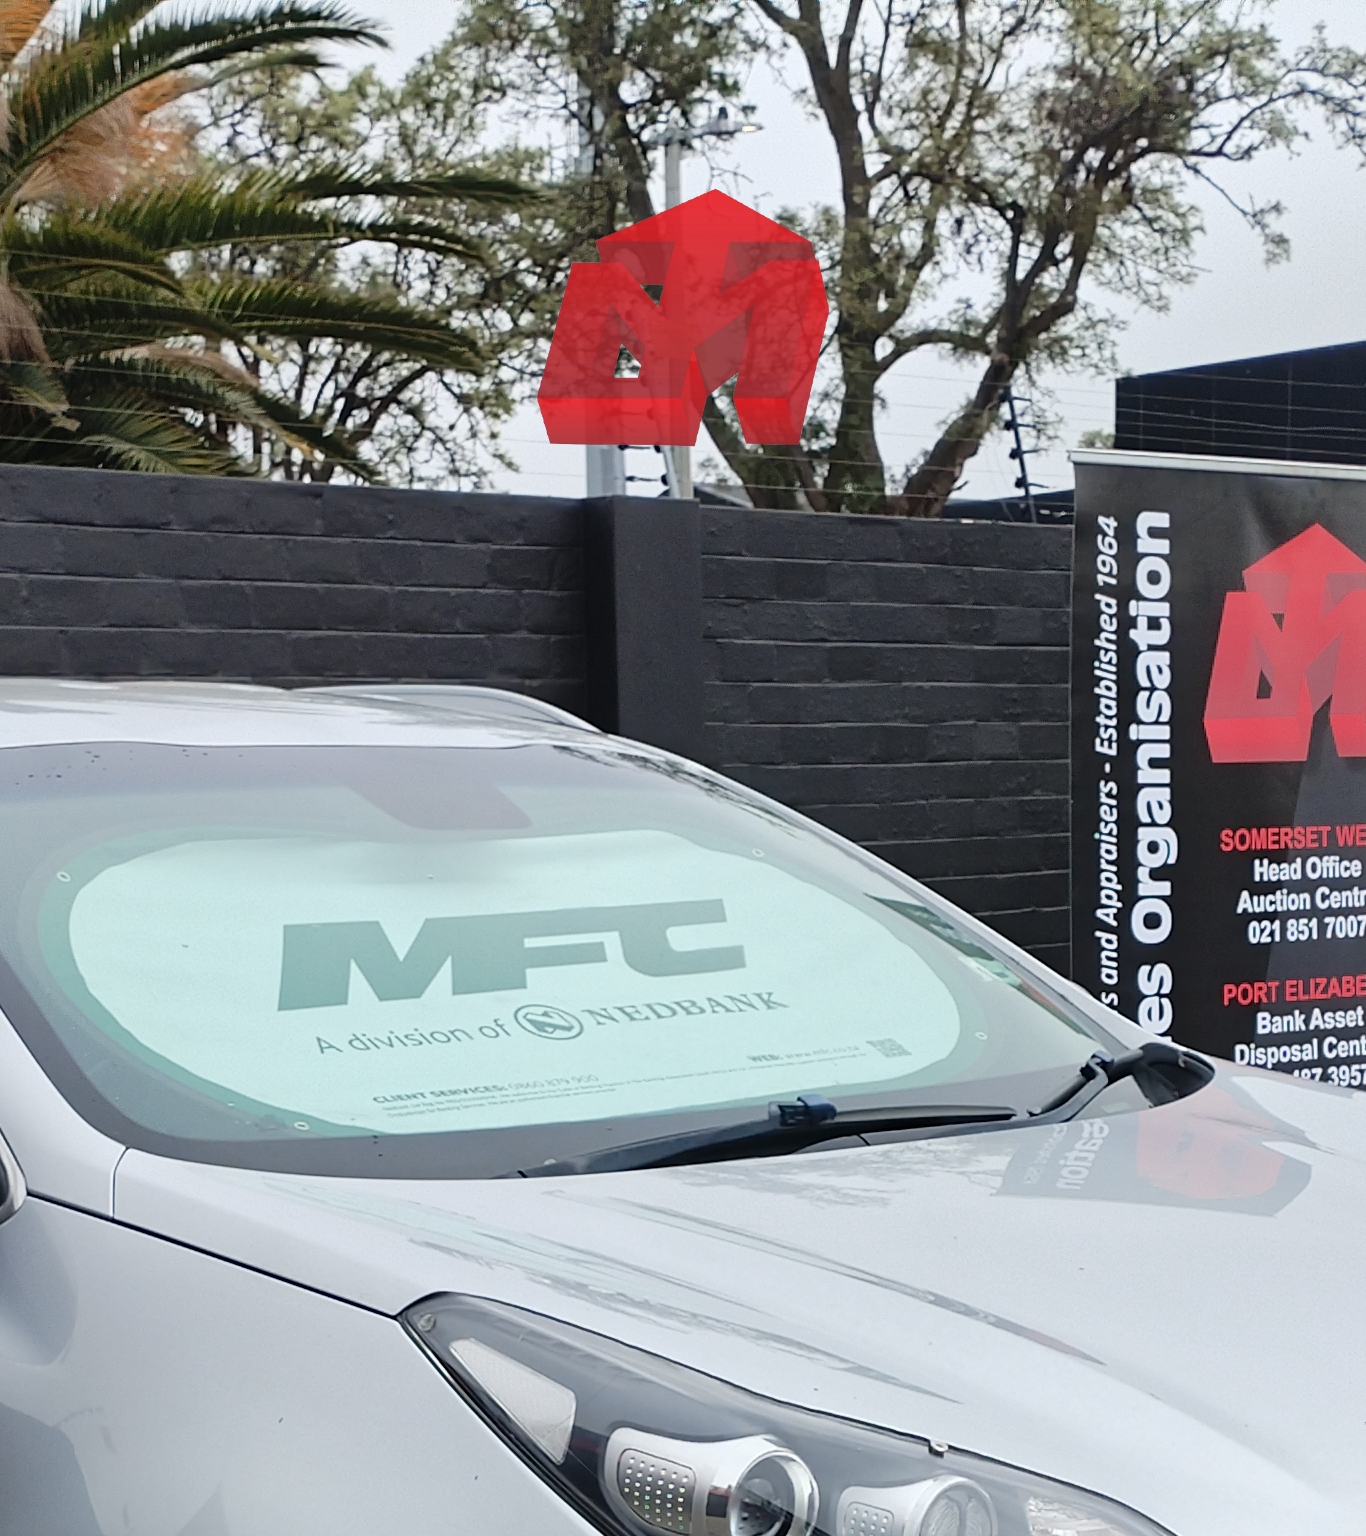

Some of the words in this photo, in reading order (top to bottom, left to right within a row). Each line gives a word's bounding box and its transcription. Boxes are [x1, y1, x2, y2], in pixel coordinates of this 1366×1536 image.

[1096, 515, 1119, 587] 1964
[1094, 594, 1118, 756] Established
[1094, 779, 1123, 927] Appraisers
[1220, 825, 1331, 852] SOMERSET
[1253, 857, 1302, 882] Head
[1305, 855, 1362, 880] Office
[1236, 889, 1311, 914] Auction
[1248, 919, 1281, 944] 021
[1286, 917, 1318, 941] 851
[277, 898, 747, 1011] MFC
[1094, 931, 1119, 985] and
[1223, 980, 1279, 1007] PORT
[316, 1035, 343, 1055] A
[348, 1022, 473, 1054] division
[478, 1018, 512, 1040] of
[581, 991, 790, 1027] NEDBANK
[1256, 1010, 1306, 1034] Bank
[1309, 1005, 1365, 1031] Asset
[1234, 1037, 1318, 1069] Disposal
[373, 1091, 427, 1105] CLIENT
[429, 1084, 508, 1099] SERVICES:
